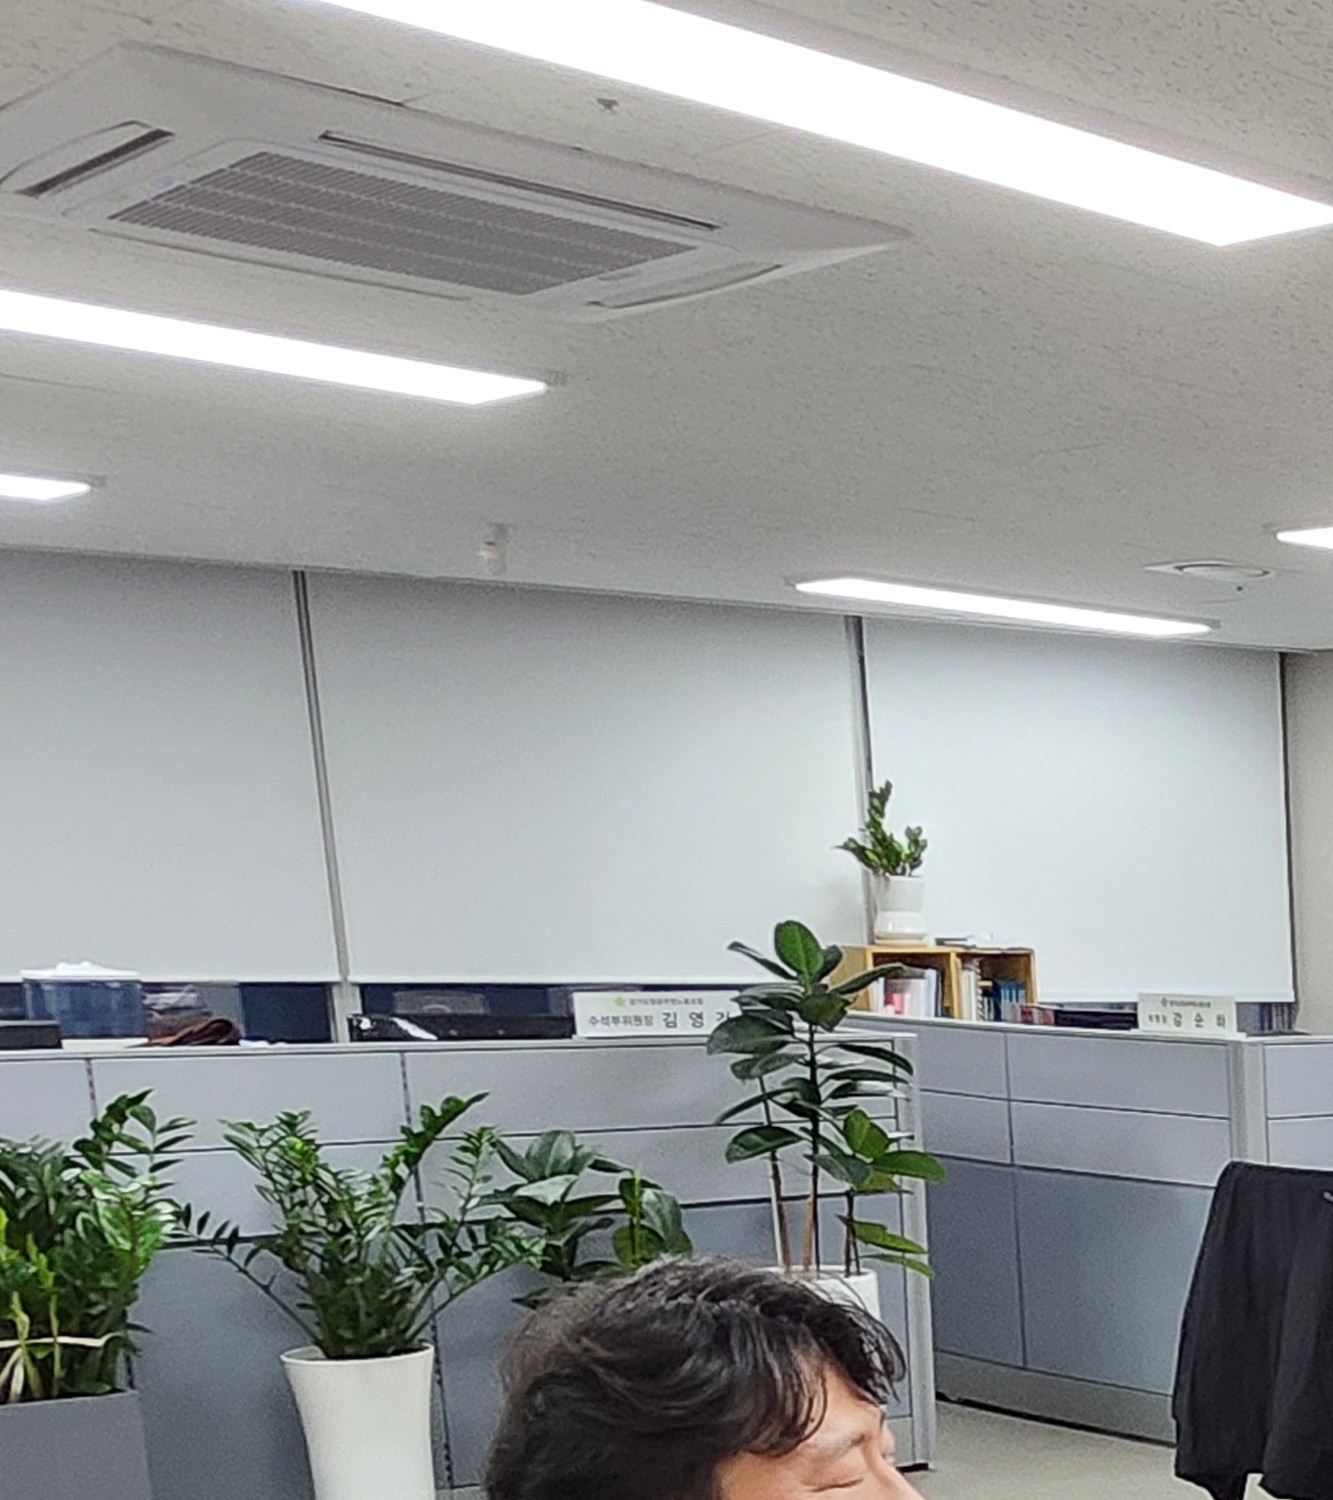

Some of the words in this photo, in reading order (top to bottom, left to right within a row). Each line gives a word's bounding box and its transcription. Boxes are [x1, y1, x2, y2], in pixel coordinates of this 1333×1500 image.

[588, 1014, 654, 1027] 수석부위원장
[662, 1012, 678, 1029] 김
[688, 1011, 705, 1029] 영
